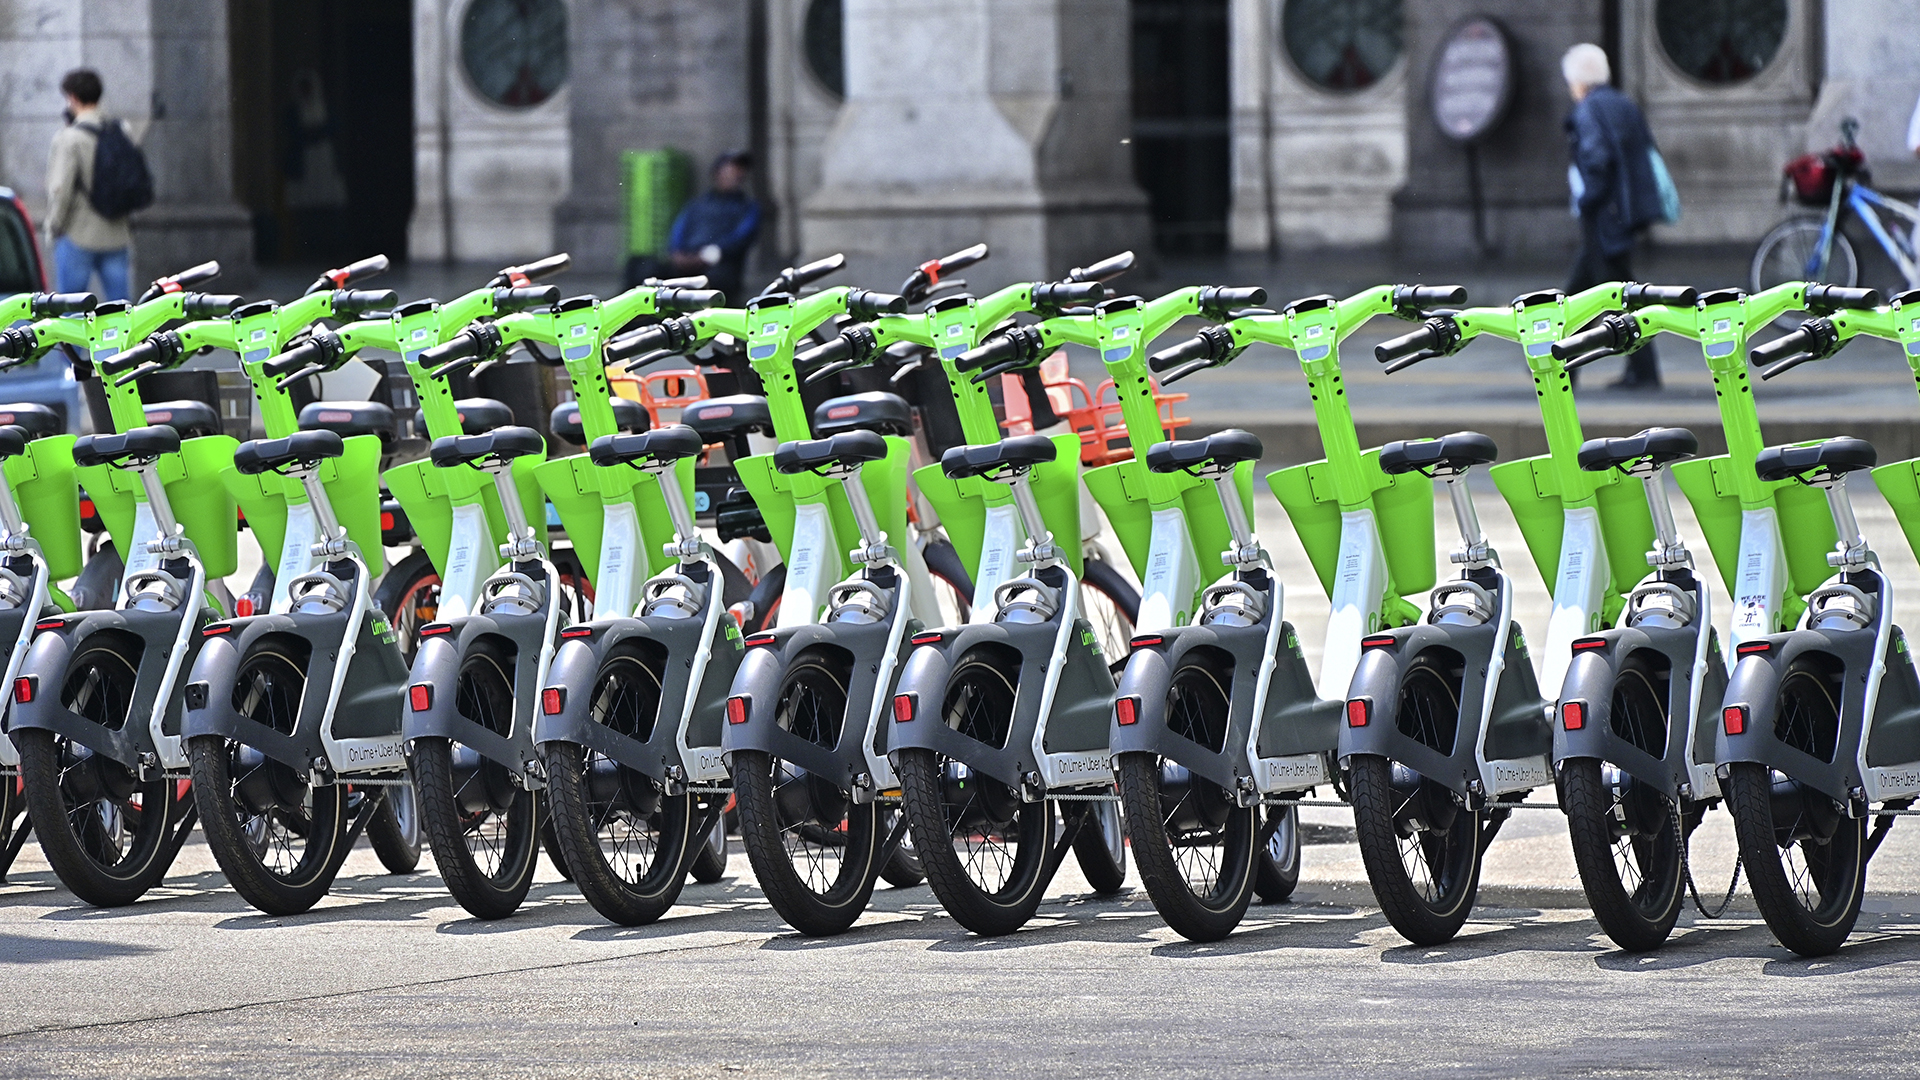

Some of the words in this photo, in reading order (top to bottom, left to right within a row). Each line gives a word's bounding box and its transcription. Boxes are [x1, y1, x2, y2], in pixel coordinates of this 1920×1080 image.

[370, 618, 387, 635] Lime
[724, 624, 740, 640] Lime
[349, 748, 360, 762] On
[358, 746, 374, 760] Lime
[377, 743, 393, 757] Uber
[701, 755, 711, 770] On
[1059, 759, 1069, 774] On
[1067, 758, 1082, 772] Lime
[1085, 757, 1100, 770] Uber
[1277, 762, 1290, 776] Lime
[1292, 762, 1305, 776] Uber
[1503, 766, 1516, 781] Lime
[1887, 772, 1900, 787] Lime
[1902, 772, 1916, 787] Uber
